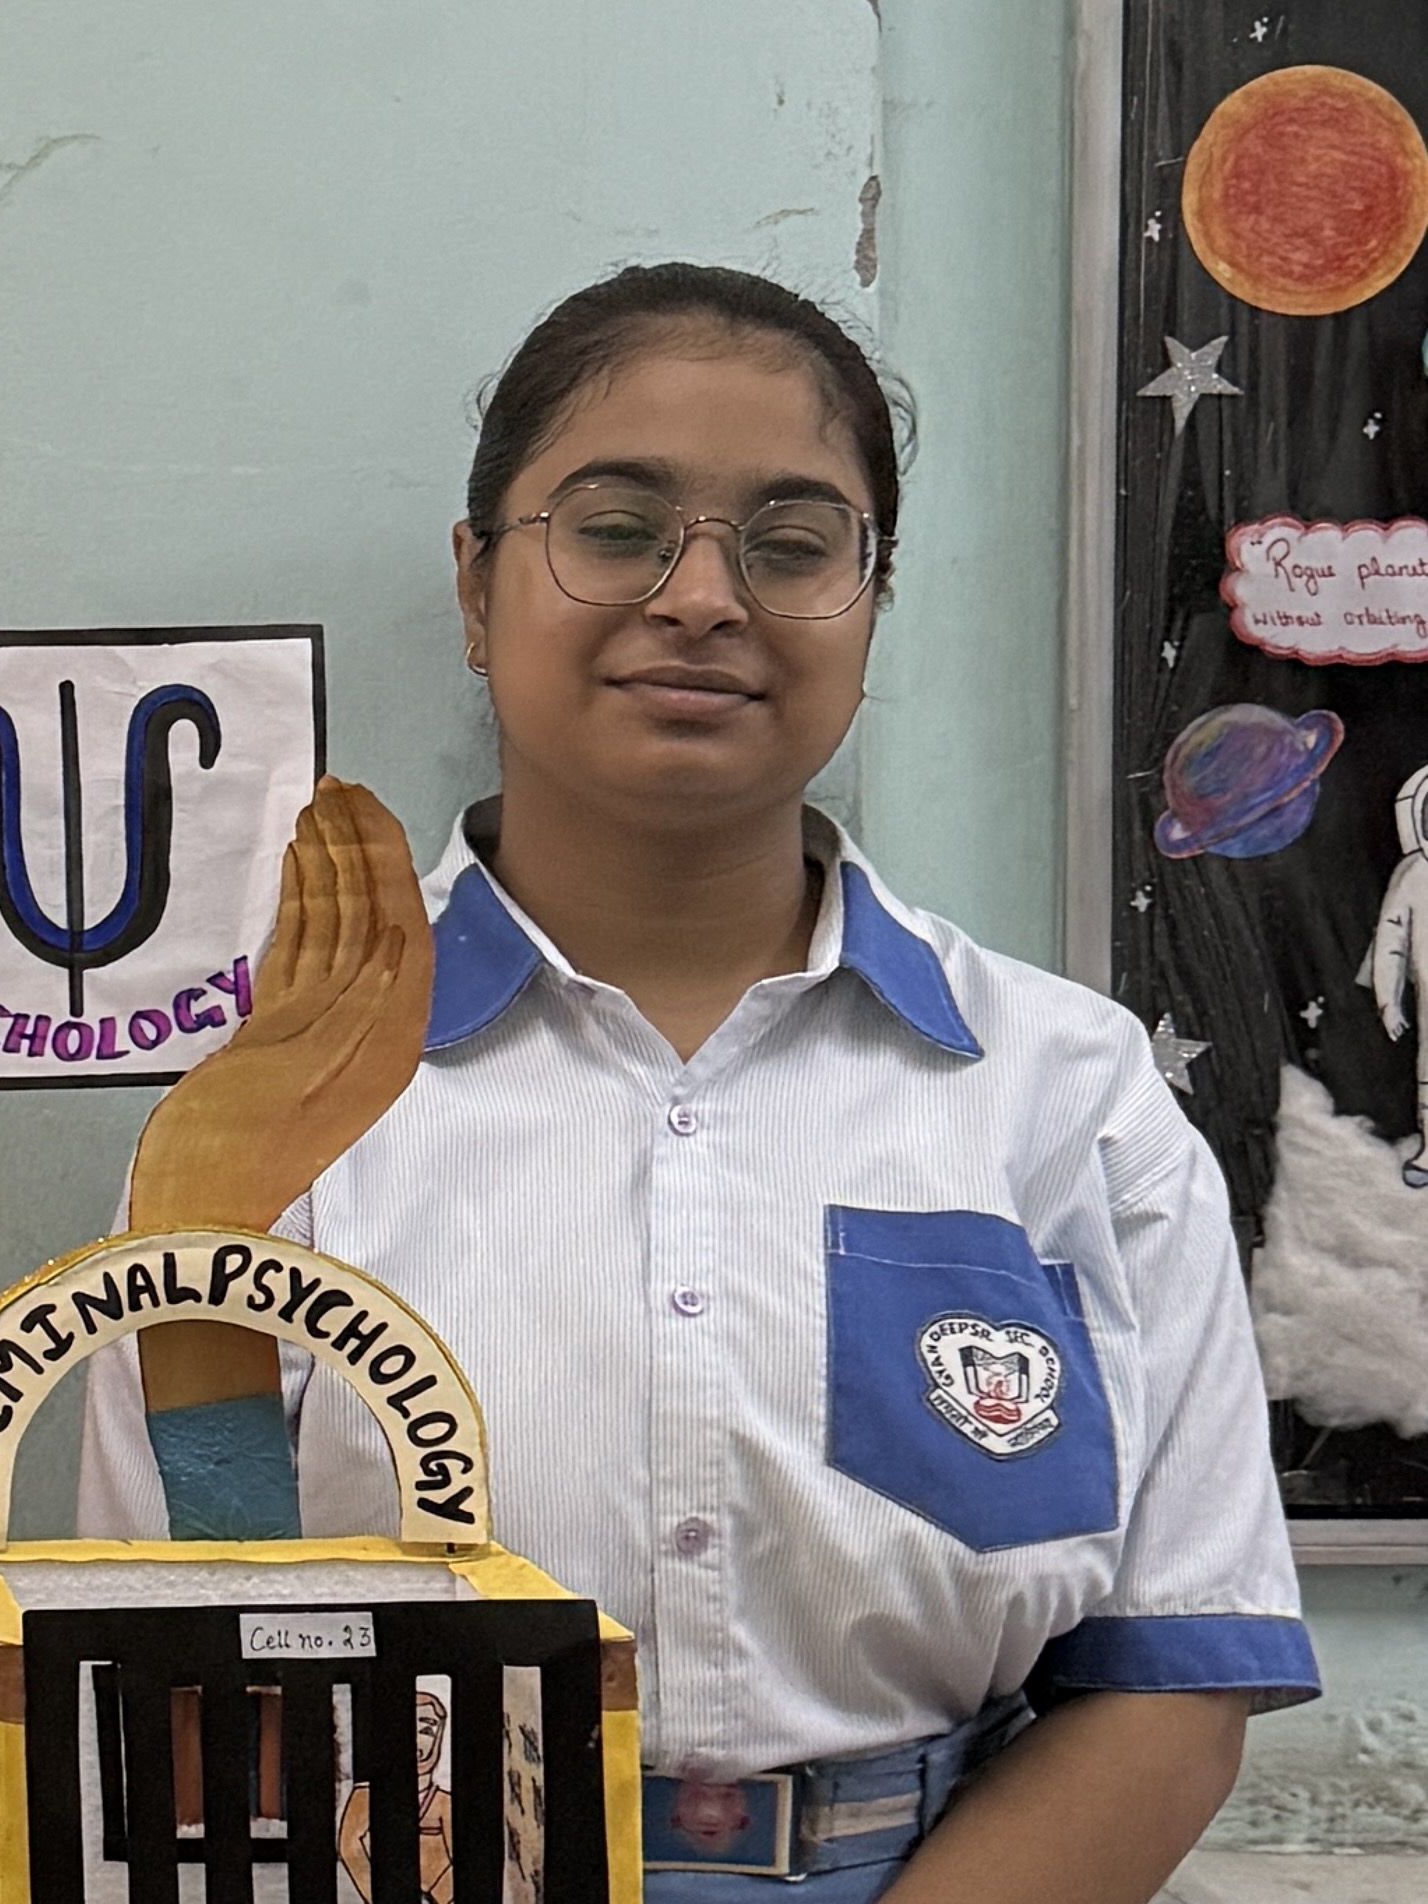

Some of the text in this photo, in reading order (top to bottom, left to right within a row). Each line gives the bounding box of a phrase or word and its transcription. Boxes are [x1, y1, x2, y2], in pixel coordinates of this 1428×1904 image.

[251, 1624, 371, 1651] Cell no. 23
